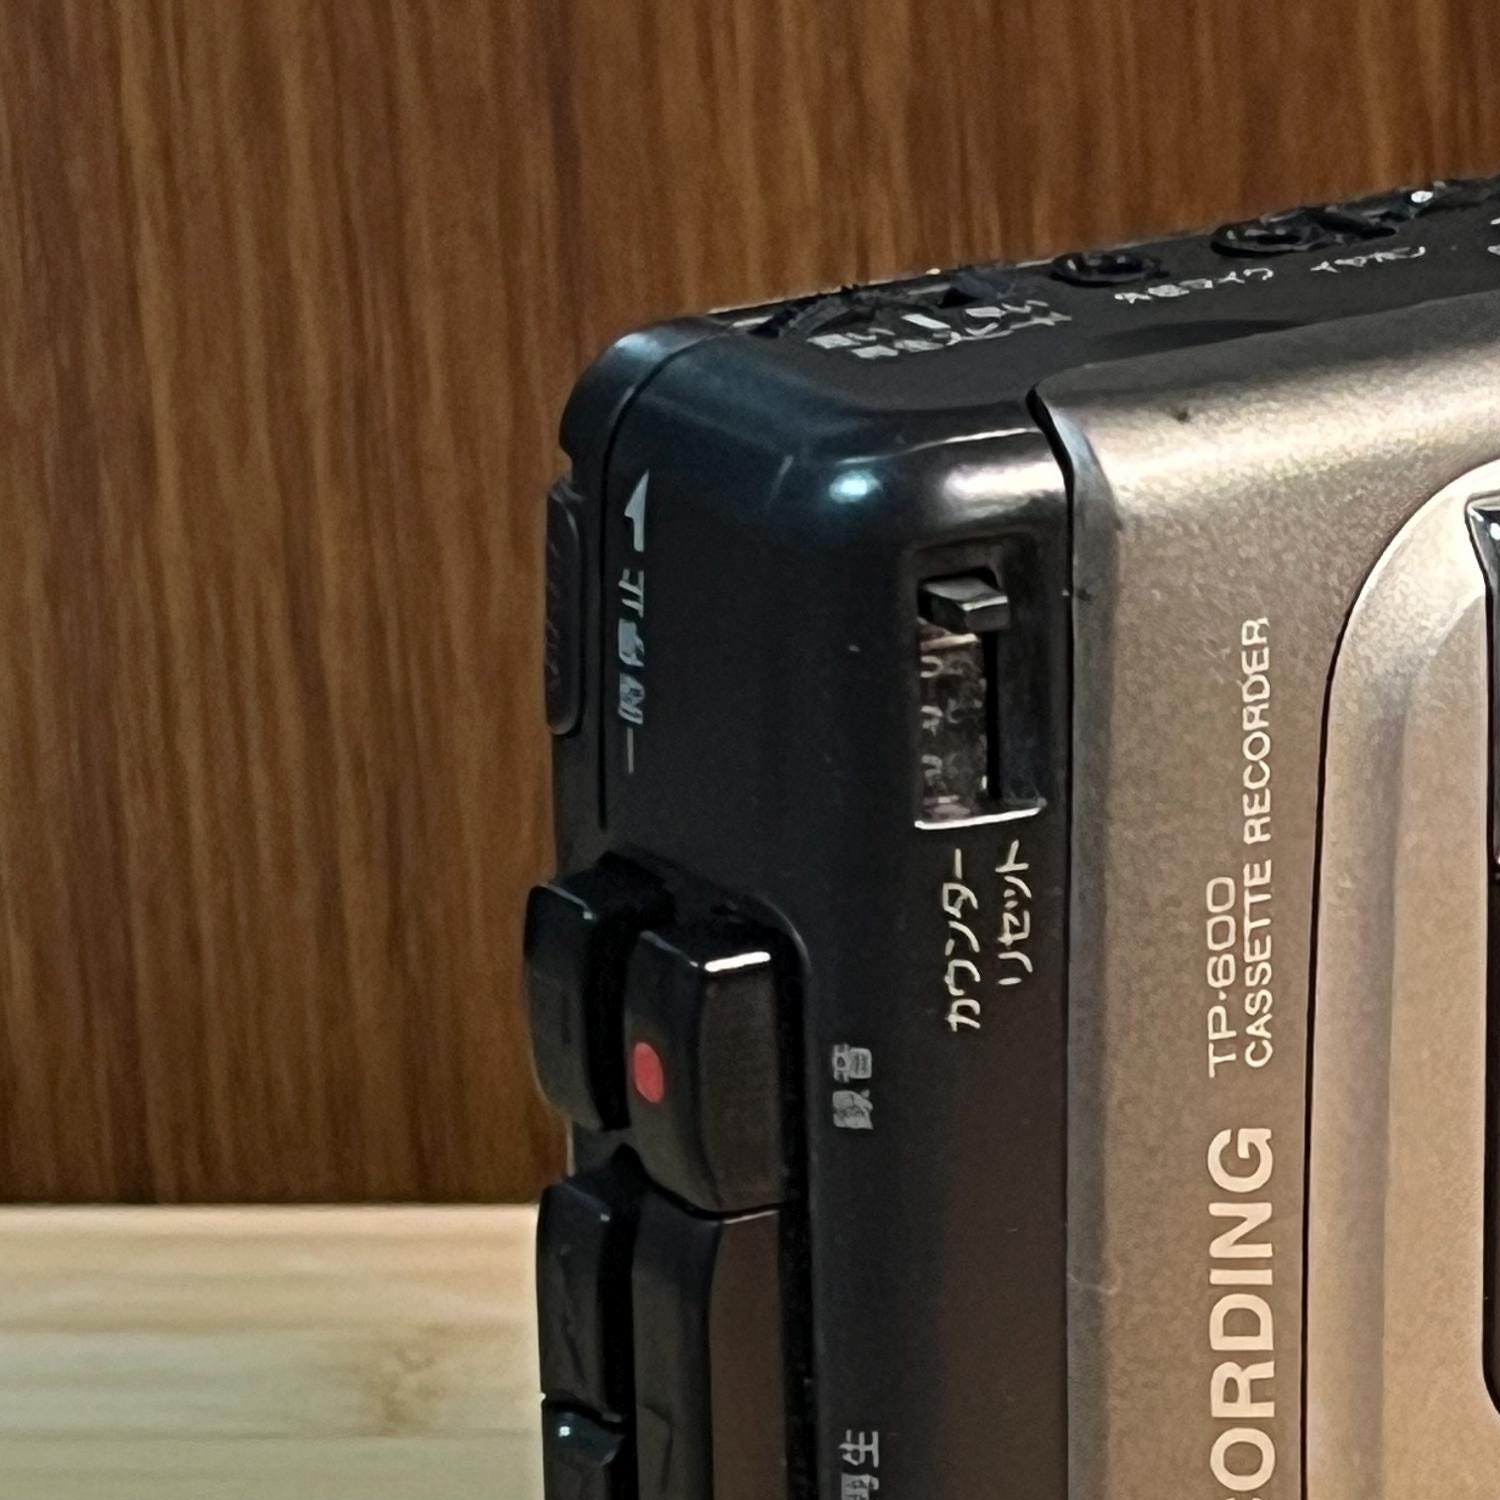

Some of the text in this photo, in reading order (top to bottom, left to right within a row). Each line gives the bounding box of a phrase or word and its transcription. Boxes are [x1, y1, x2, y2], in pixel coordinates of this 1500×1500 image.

[995, 839, 1032, 985] リセット
[1240, 615, 1275, 1070] CASSETTE RECORDER
[941, 848, 982, 1031] カウンター
